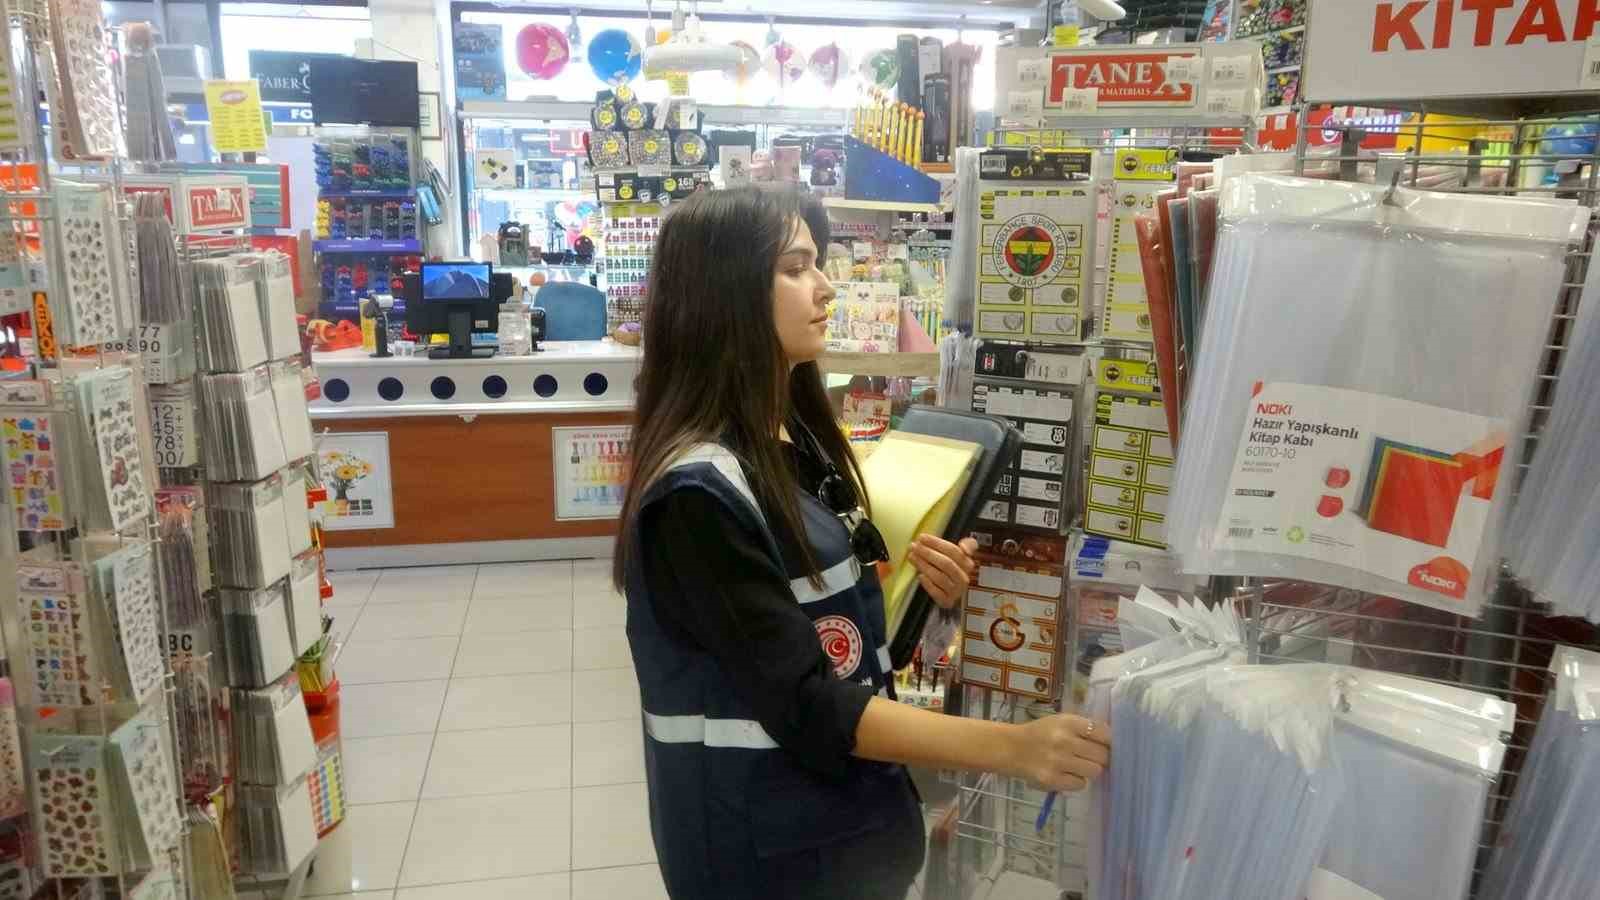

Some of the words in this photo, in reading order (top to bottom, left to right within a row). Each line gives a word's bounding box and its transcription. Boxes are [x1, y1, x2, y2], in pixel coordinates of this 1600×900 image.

[1106, 87, 1150, 97] MATERIALS
[1256, 403, 1293, 416] NOKI
[1253, 417, 1284, 430] Hazır
[1287, 419, 1360, 440] Yapışkanlı
[1249, 432, 1280, 445] Kitap
[1283, 434, 1314, 447] Kabı
